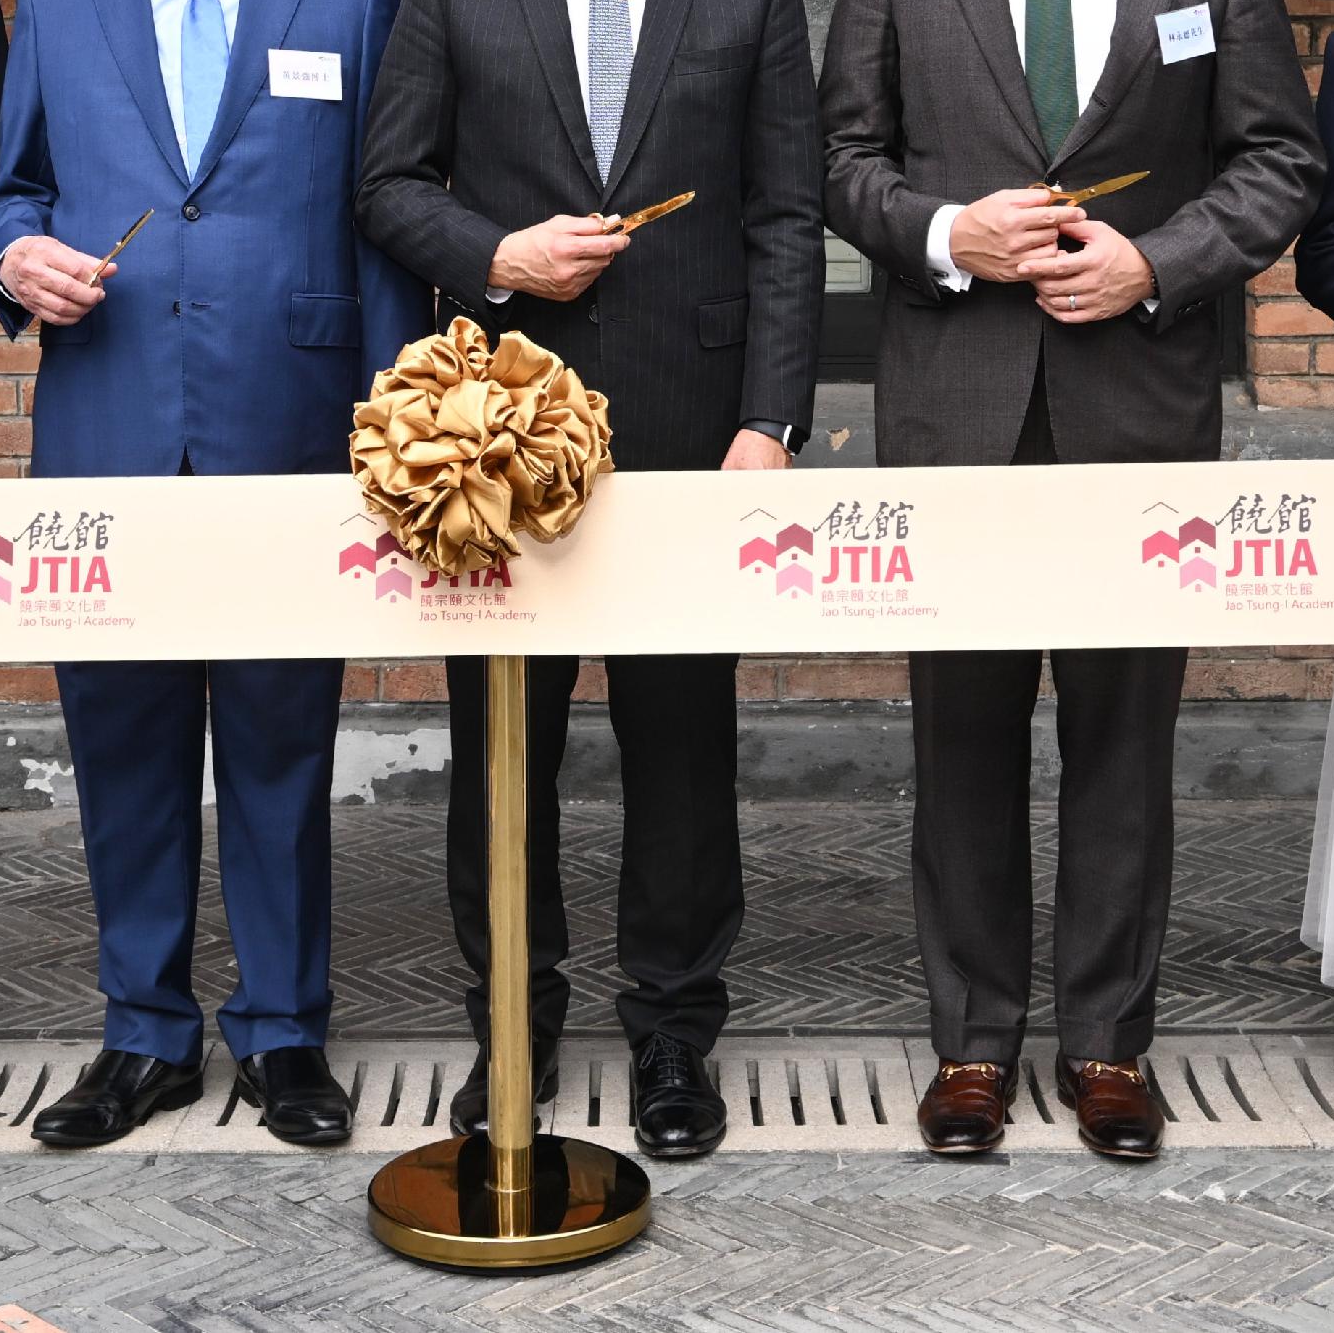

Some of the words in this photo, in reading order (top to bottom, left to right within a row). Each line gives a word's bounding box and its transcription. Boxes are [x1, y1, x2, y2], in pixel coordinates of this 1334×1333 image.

[1225, 538, 1318, 577] JTIA
[821, 545, 914, 584] JTIA
[20, 556, 112, 594] JTIA
[821, 606, 840, 617] Jao
[886, 605, 939, 618] Academy
[1225, 600, 1243, 611] Jao
[18, 616, 36, 627] Jao
[84, 616, 136, 628] Academy
[419, 611, 437, 622] Jao
[484, 610, 537, 623] Academy
